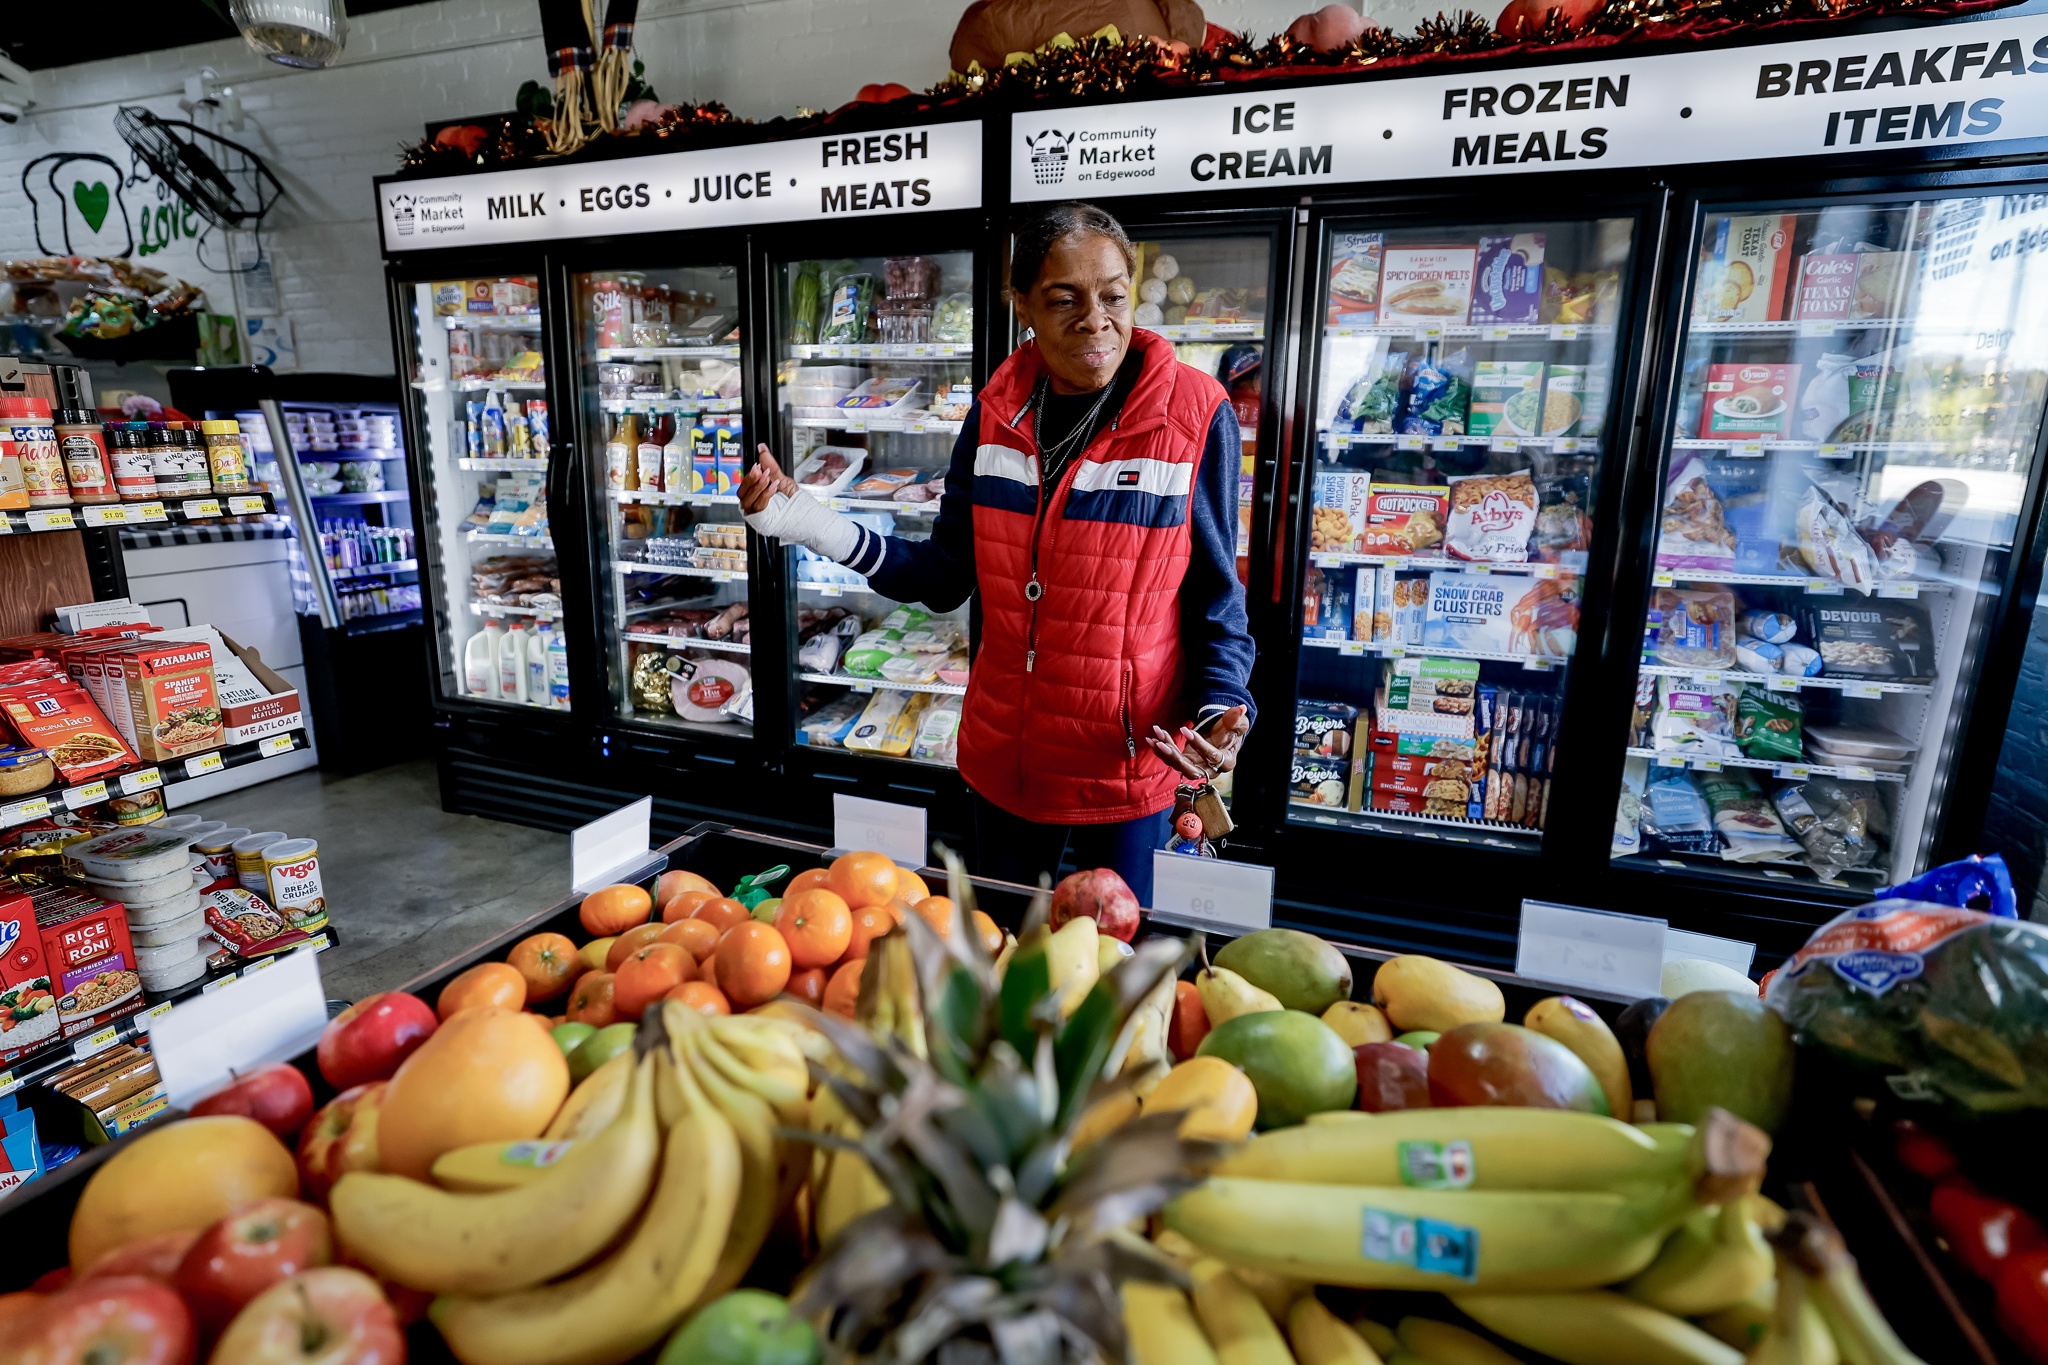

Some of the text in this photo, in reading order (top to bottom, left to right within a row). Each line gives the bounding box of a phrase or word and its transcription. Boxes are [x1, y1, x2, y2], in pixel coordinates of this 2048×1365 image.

[1442, 74, 1630, 120] FROZEN
[1232, 101, 1296, 135] ICE
[1824, 97, 2005, 147] ITEMS
[1079, 126, 1157, 142] Community
[821, 131, 929, 168] FRESH
[1080, 144, 1156, 166] Market
[1452, 126, 1609, 167] MEALS
[1190, 145, 1333, 182] CREAM
[1078, 167, 1156, 181] on Edgewood
[418, 192, 463, 205] Community
[487, 171, 772, 221] MILK EGGS JUICE
[820, 179, 931, 214] MEATS
[420, 205, 464, 222] Market
[433, 223, 466, 234] Edgewood
[1741, 229, 1752, 257] TOAST
[1751, 227, 1761, 256] TEXAS
[1772, 232, 1783, 248] IGA
[1386, 270, 1470, 281] SPICY CHICKEN MELTS
[1806, 259, 1854, 275] Cole's
[1489, 248, 1511, 312] Uncrustables
[1817, 276, 1842, 284] Garlic
[1803, 286, 1850, 299] TEXAS
[593, 290, 622, 314] Silk
[1802, 300, 1848, 313] TOAST
[1976, 328, 2014, 351] Dairy
[1742, 369, 1769, 380] Tyson
[213, 452, 241, 471] Dash
[1325, 476, 1336, 508] SHRIMP
[1335, 476, 1345, 509] POPCORN
[1349, 476, 1364, 518] SeaPak
[1471, 506, 1524, 525] Arby's
[1435, 587, 1504, 602] SNOW CRAB
[1476, 582, 1500, 590] Atlantic
[1434, 600, 1503, 616] CLUSTERS
[1820, 609, 1882, 624] DEVOUR
[1687, 627, 1696, 648] BRATS
[153, 650, 211, 668] ZATARAIN'S
[1421, 666, 1448, 674] Vegetable
[1450, 667, 1460, 675] Egg
[164, 677, 201, 690] SPANISH
[174, 685, 195, 694] RICE
[251, 707, 284, 720] MEATLOAF
[253, 701, 280, 713] CLASSIC
[30, 723, 64, 734] ORIGINAL
[61, 716, 92, 727] Taco
[240, 716, 298, 737] MEATLOAF
[1295, 716, 1346, 734] Breyers
[1402, 717, 1435, 726] CHICKEN
[1436, 719, 1449, 727] POT
[1451, 719, 1463, 728] PIE
[1291, 766, 1341, 784] Breyers
[1381, 783, 1418, 792] ENCHILADAS
[1654, 793, 1692, 803] Salmon
[282, 886, 318, 900] CRUMBS
[284, 880, 315, 893] BREAD
[213, 891, 228, 903] RED
[65, 923, 106, 945] RICE
[69, 938, 110, 961] RONI
[21, 955, 28, 963] 5
[67, 955, 119, 978] STIR FRIED RICE
[133, 1103, 158, 1116] Calories
